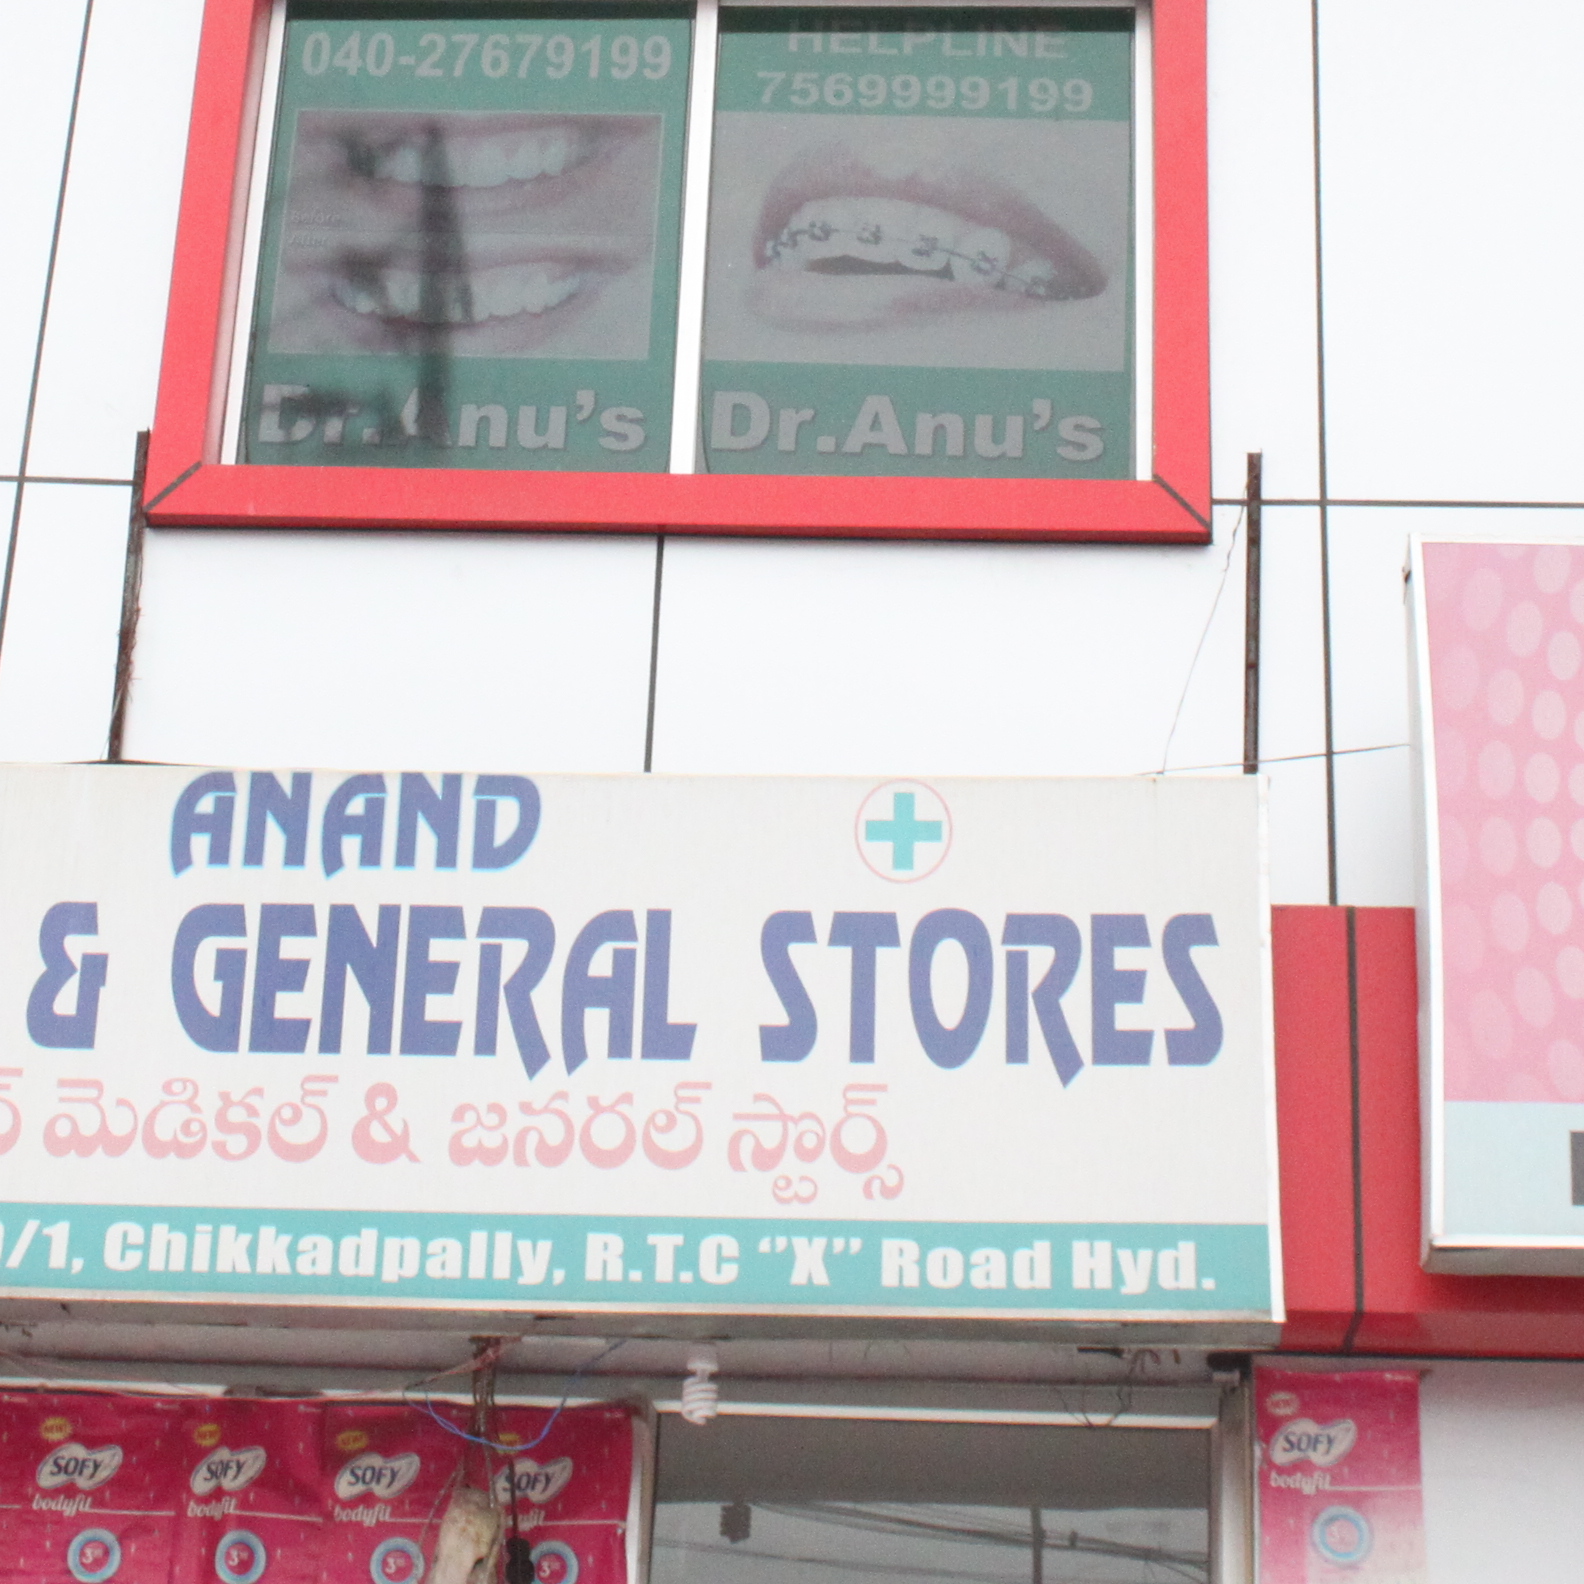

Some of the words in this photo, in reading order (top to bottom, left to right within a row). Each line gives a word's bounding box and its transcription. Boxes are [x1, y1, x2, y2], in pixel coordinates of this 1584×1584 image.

[301, 29, 673, 83] 040-27679199
[787, 17, 1069, 59] HELPLINE
[756, 70, 1094, 114] 7569999199
[710, 390, 1105, 463] Dr.Anu's
[171, 772, 541, 878] ANAND
[26, 901, 108, 1050] &
[171, 903, 698, 1081] GENERAL
[758, 907, 1225, 1089] STORES
[42, 1073, 339, 1164] మెడికల్
[351, 1081, 421, 1164] &
[448, 1080, 713, 1171] జనరల్
[104, 1220, 566, 1285] Chikkadpally,
[585, 1232, 740, 1285] R.T.C
[881, 1237, 1052, 1290] Road
[1072, 1240, 1217, 1296] Hyd.
[1283, 1432, 1336, 1456] SOFY
[50, 1455, 104, 1479] SOFY
[203, 1459, 246, 1482] SOFY
[347, 1466, 401, 1489] SOFY
[32, 1493, 93, 1517] bodyfit
